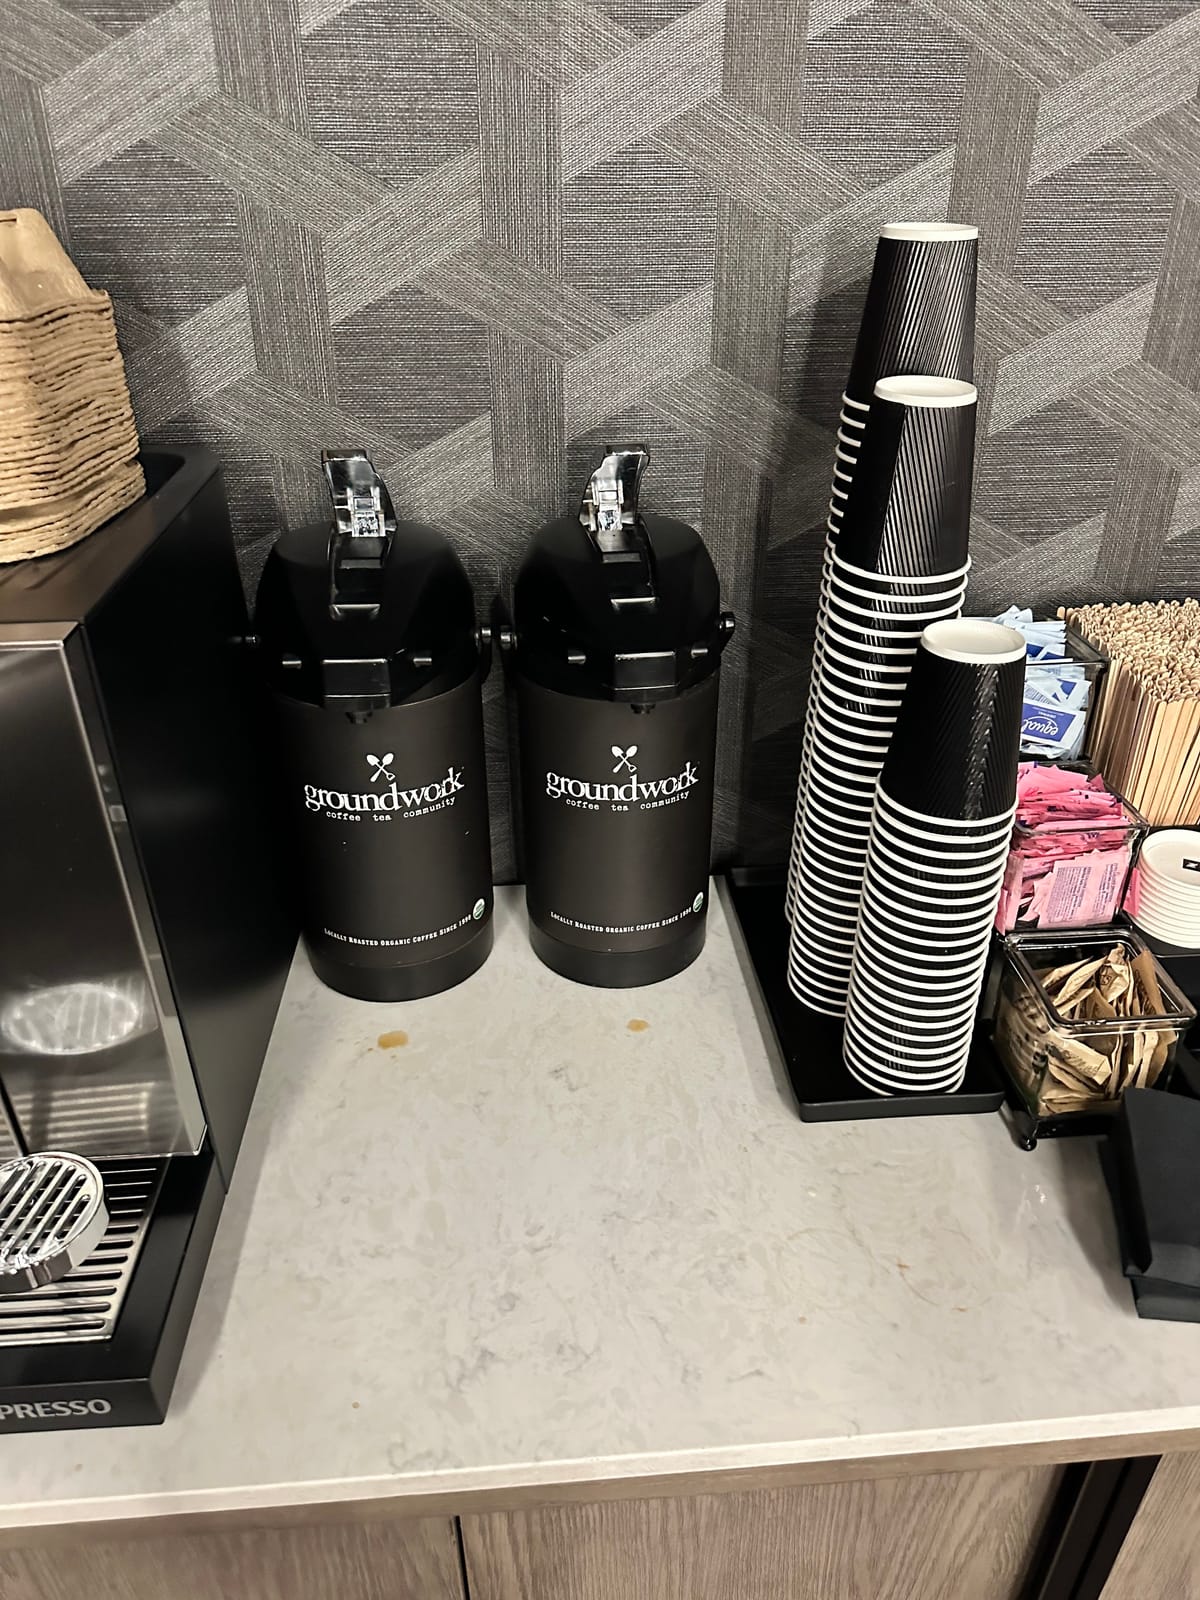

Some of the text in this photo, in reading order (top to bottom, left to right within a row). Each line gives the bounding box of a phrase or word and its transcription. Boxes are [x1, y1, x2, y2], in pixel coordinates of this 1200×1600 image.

[1021, 719, 1059, 736] equal
[304, 767, 464, 811] groundwork
[545, 762, 699, 801] groundwork
[326, 796, 456, 822] coffee tea community
[566, 790, 690, 812] coffee tea community
[0, 1399, 112, 1420] PRESSO
